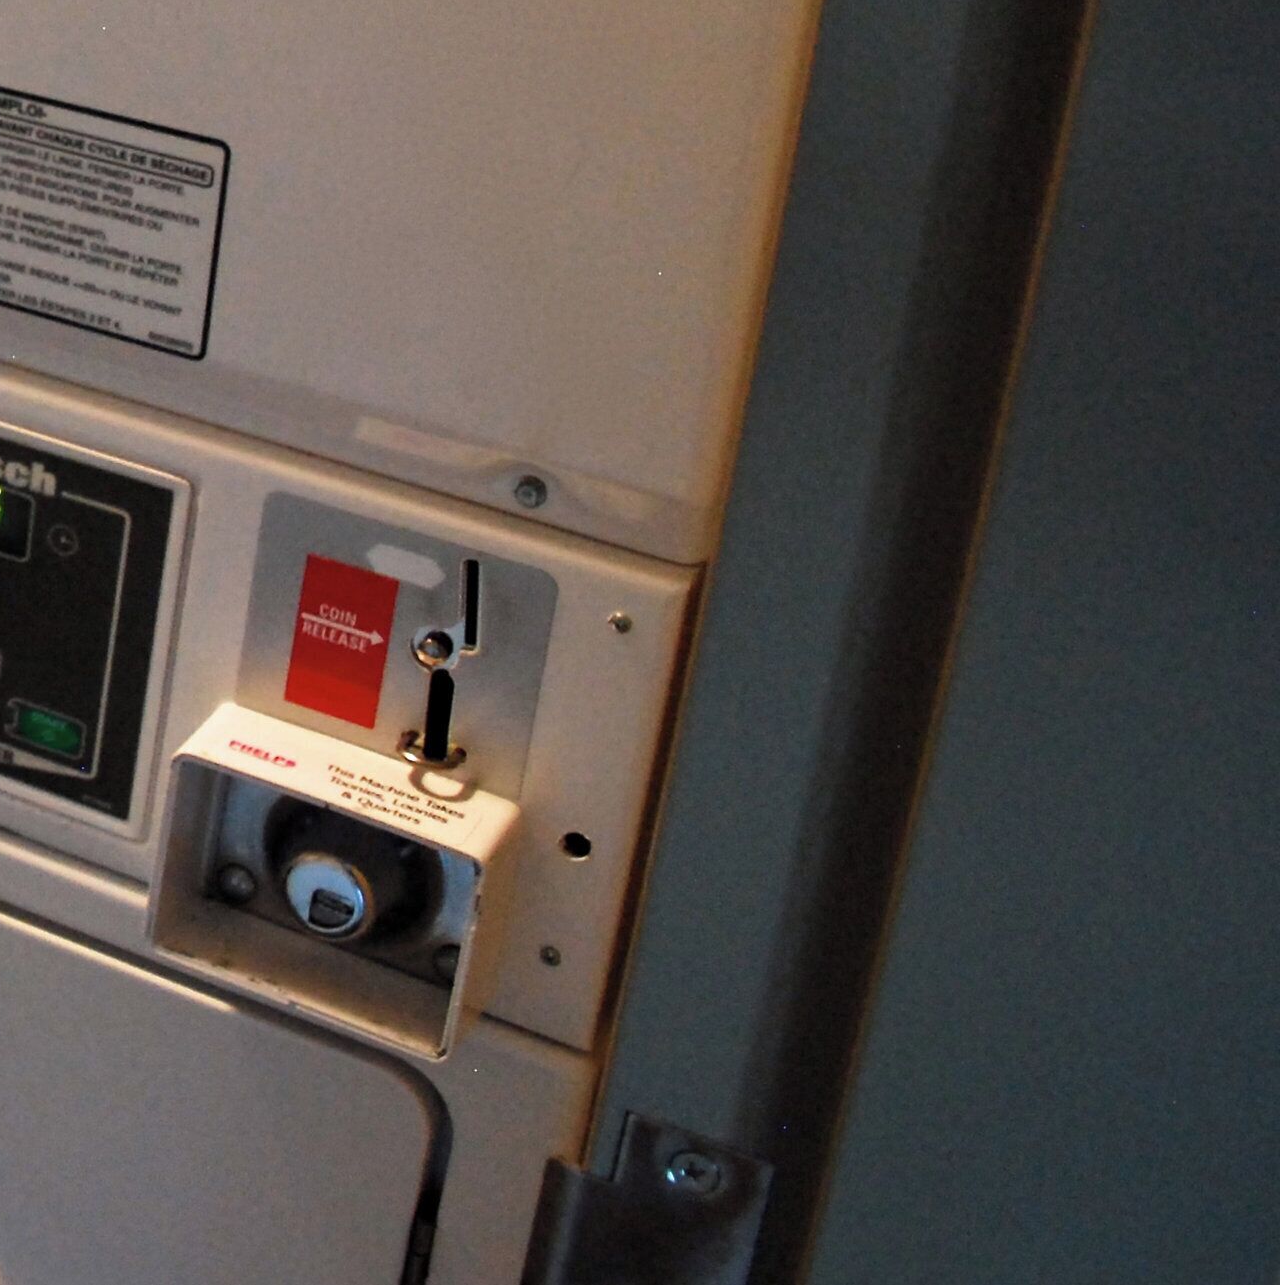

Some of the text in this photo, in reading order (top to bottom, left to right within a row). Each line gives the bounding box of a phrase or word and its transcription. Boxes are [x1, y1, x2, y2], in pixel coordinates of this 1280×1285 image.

[87, 139, 127, 161] CYCLE
[319, 603, 358, 627] COIN
[302, 620, 369, 654] RELEASE
[327, 764, 466, 820] This Machine Takes
[357, 795, 422, 826] Quarters
[391, 798, 450, 825] Loonies
